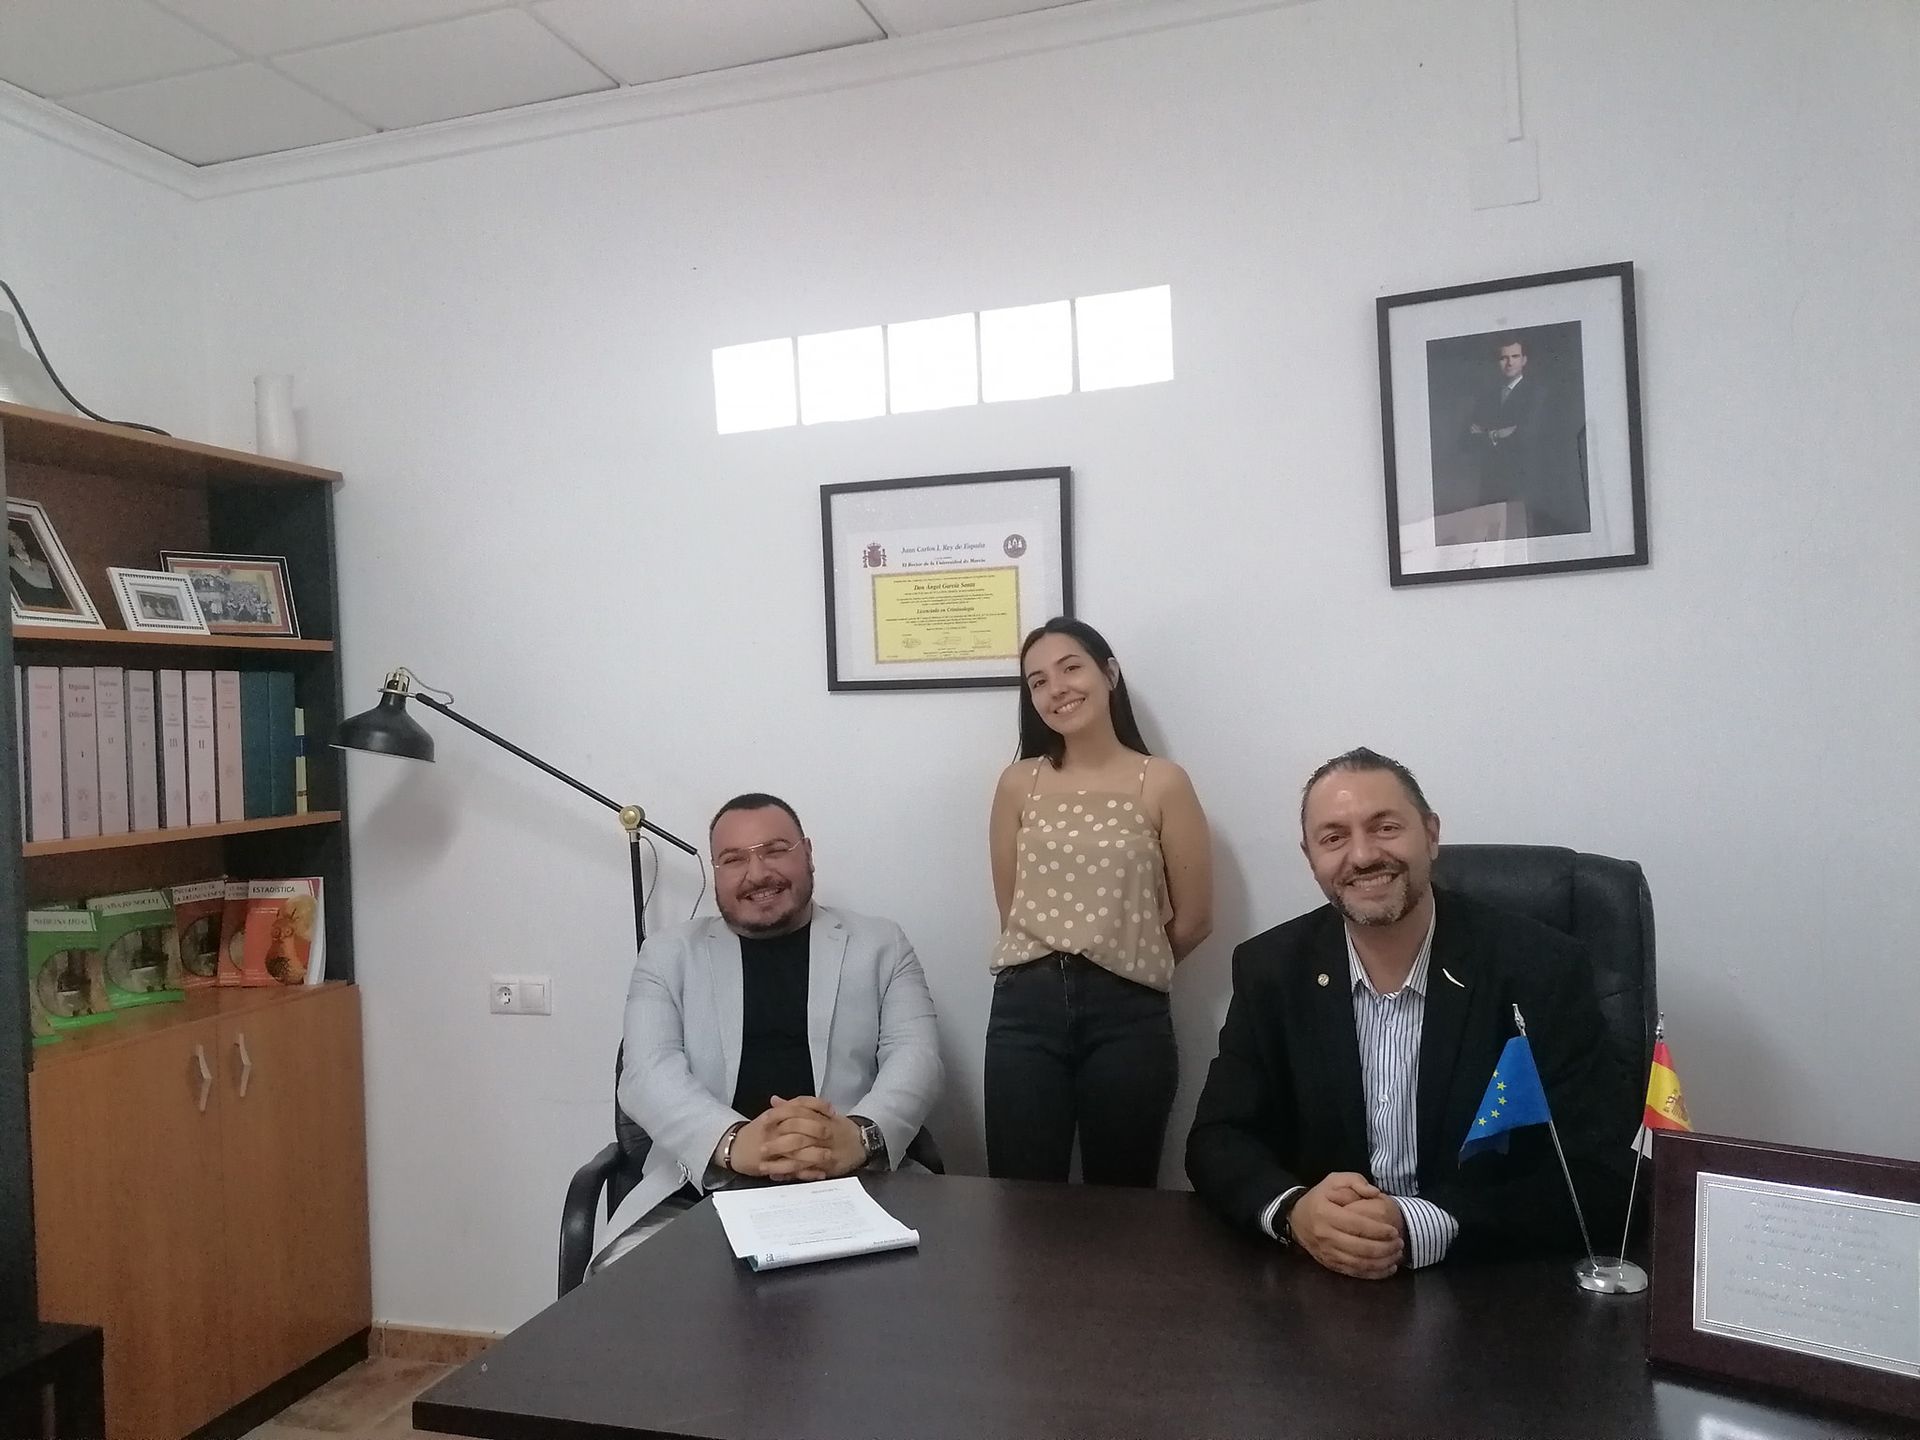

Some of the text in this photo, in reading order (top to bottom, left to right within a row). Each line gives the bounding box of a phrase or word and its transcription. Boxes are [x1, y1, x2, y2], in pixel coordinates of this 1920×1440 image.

[916, 545, 936, 553] Carlos
[942, 543, 954, 552] Rey
[935, 558, 963, 566] Universidad
